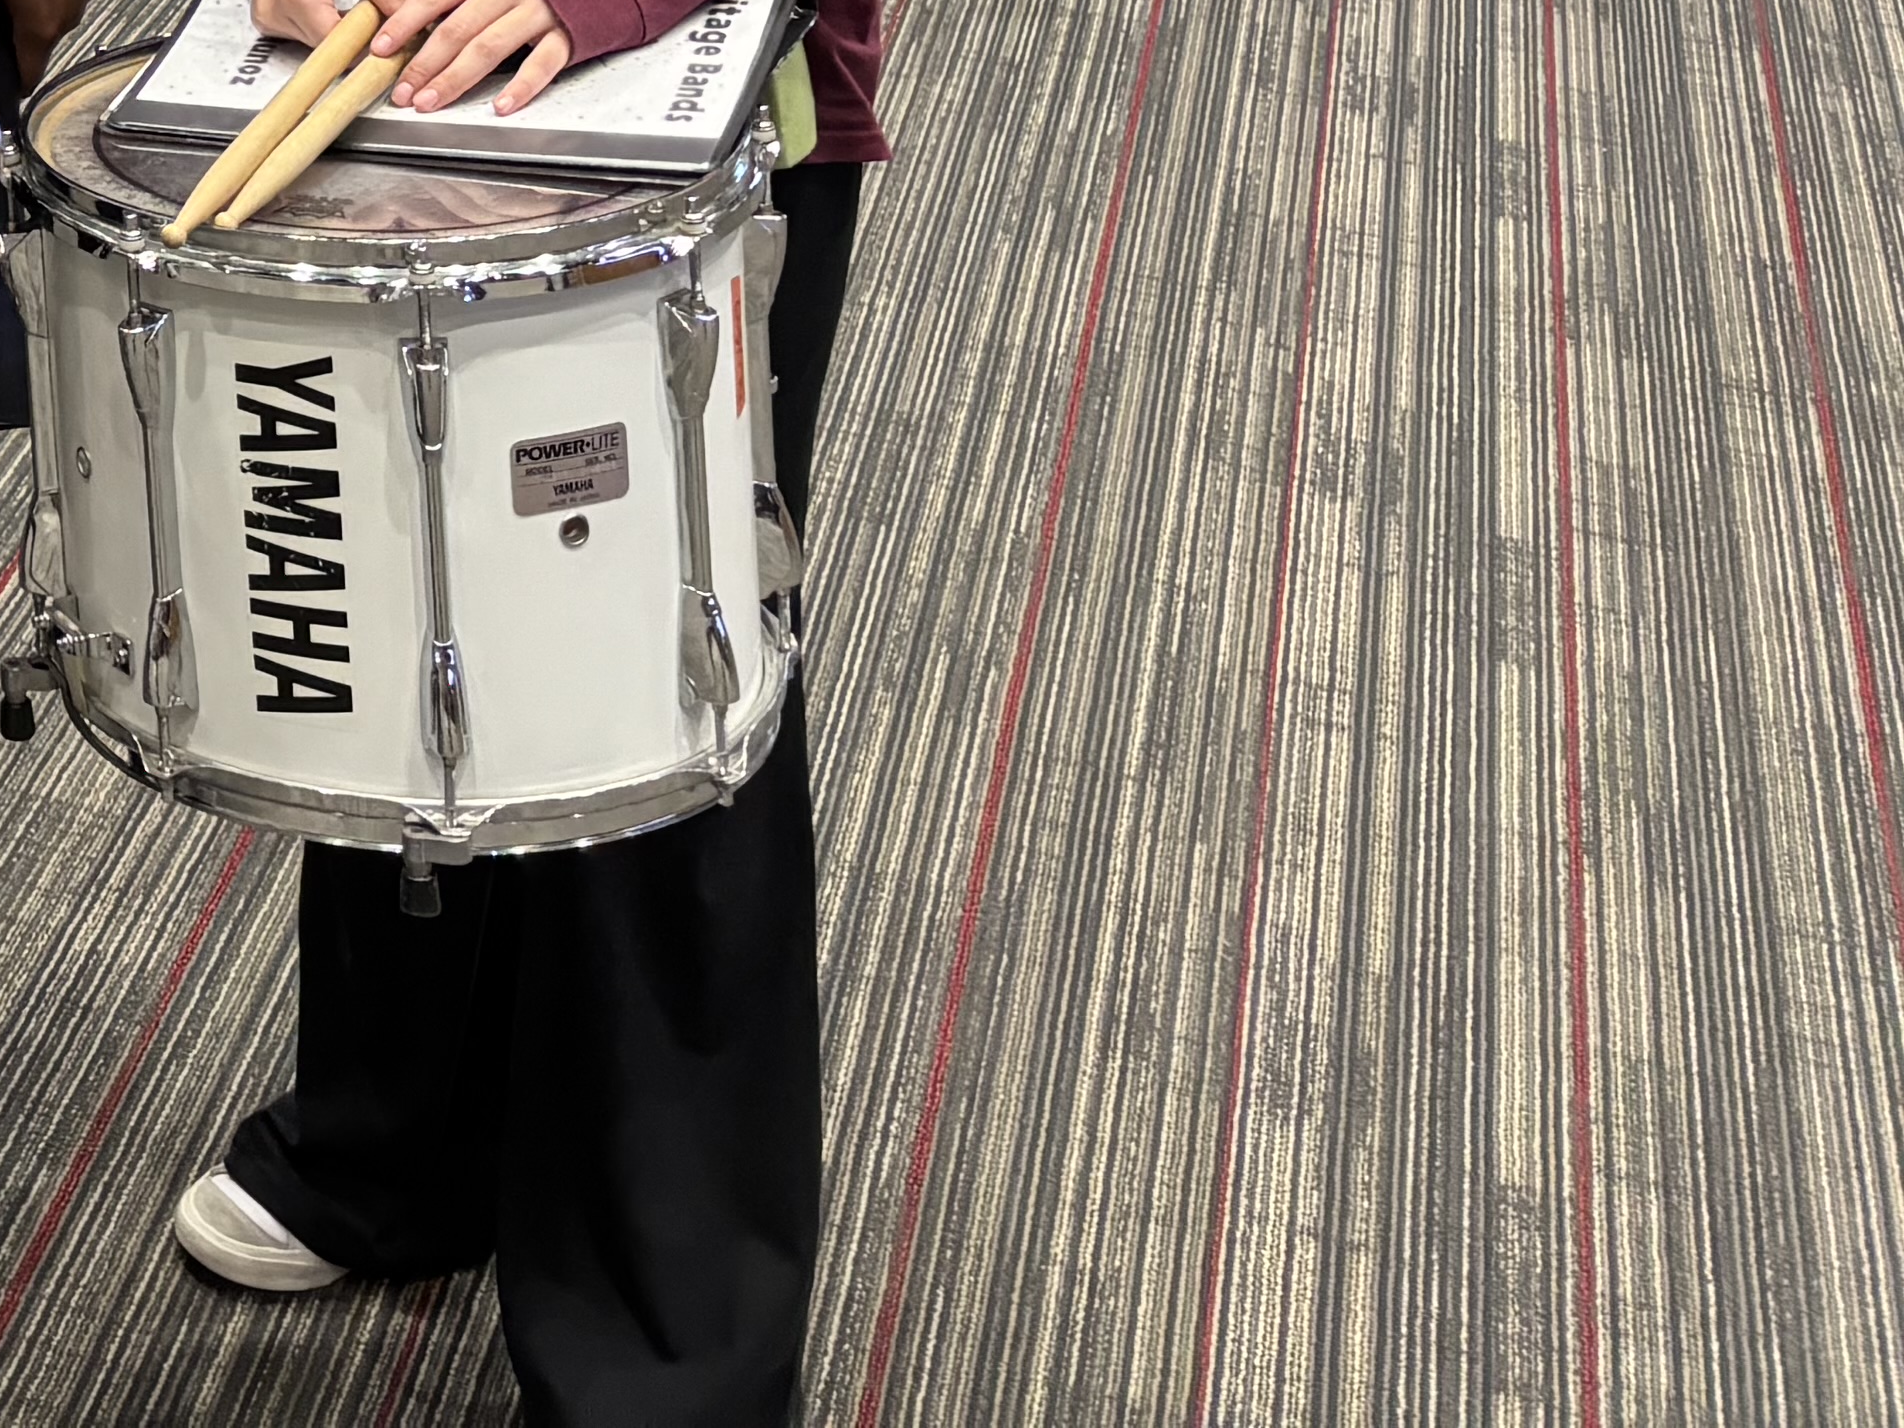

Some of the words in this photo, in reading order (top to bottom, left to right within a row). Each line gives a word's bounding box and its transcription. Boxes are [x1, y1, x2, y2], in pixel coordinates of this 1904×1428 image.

[228, 35, 284, 87] unoz
[664, 62, 725, 124] Bands
[234, 355, 355, 714] YAMAHA
